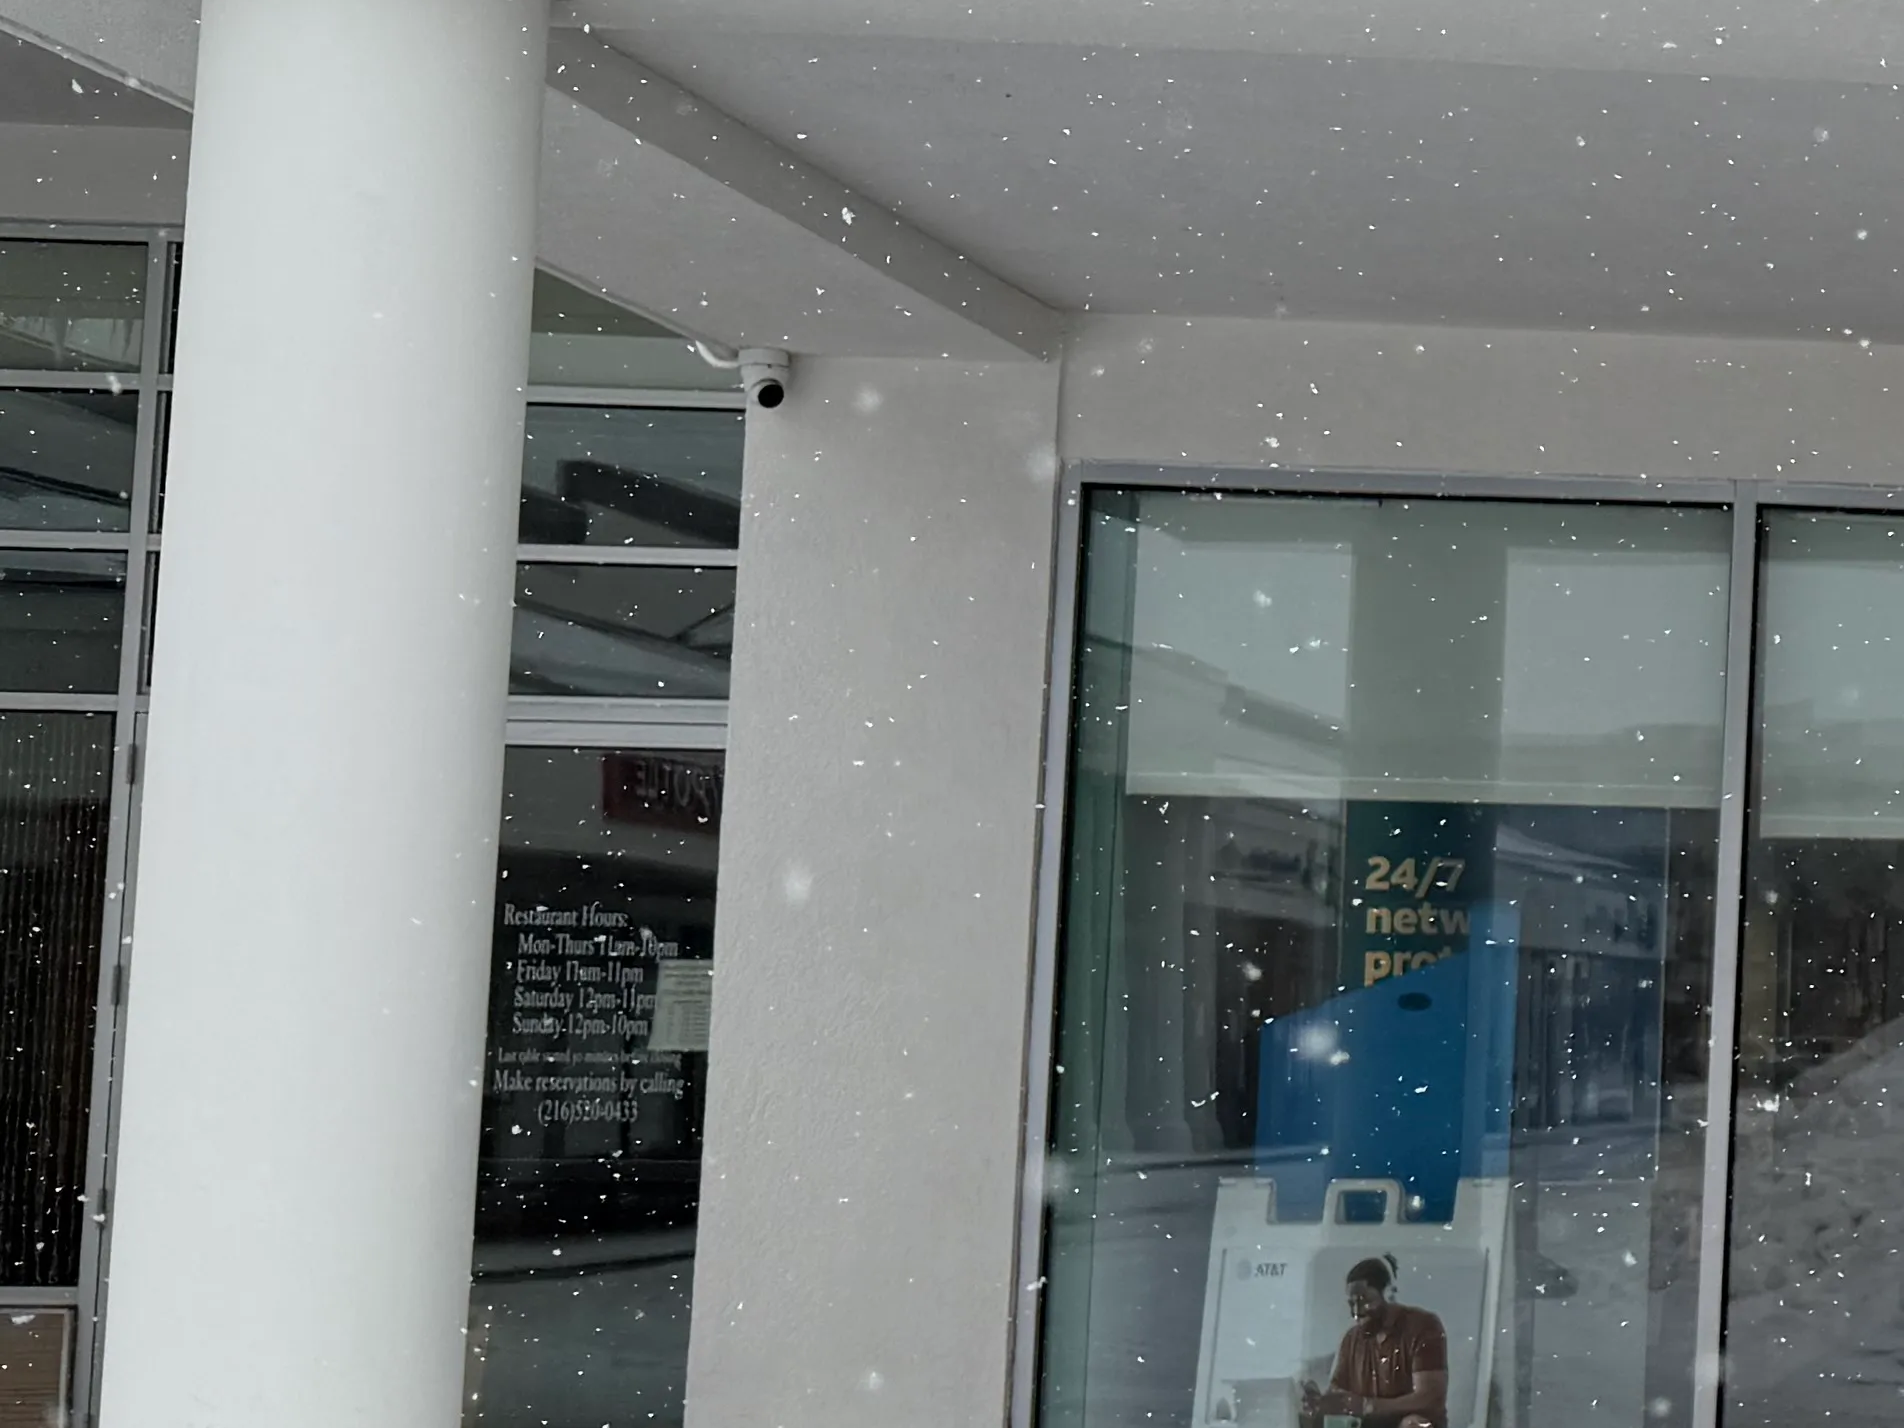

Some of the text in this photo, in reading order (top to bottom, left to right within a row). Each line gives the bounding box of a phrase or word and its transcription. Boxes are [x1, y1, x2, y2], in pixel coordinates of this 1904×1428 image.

[1365, 856, 1465, 898] 24/7
[504, 903, 578, 926] Restaurant
[518, 933, 595, 955] Mon-Thurs
[517, 960, 561, 987] Friday
[514, 986, 574, 1014] Saturday
[512, 1012, 563, 1039] Sunday
[494, 1071, 684, 1099] Make reservations by calling
